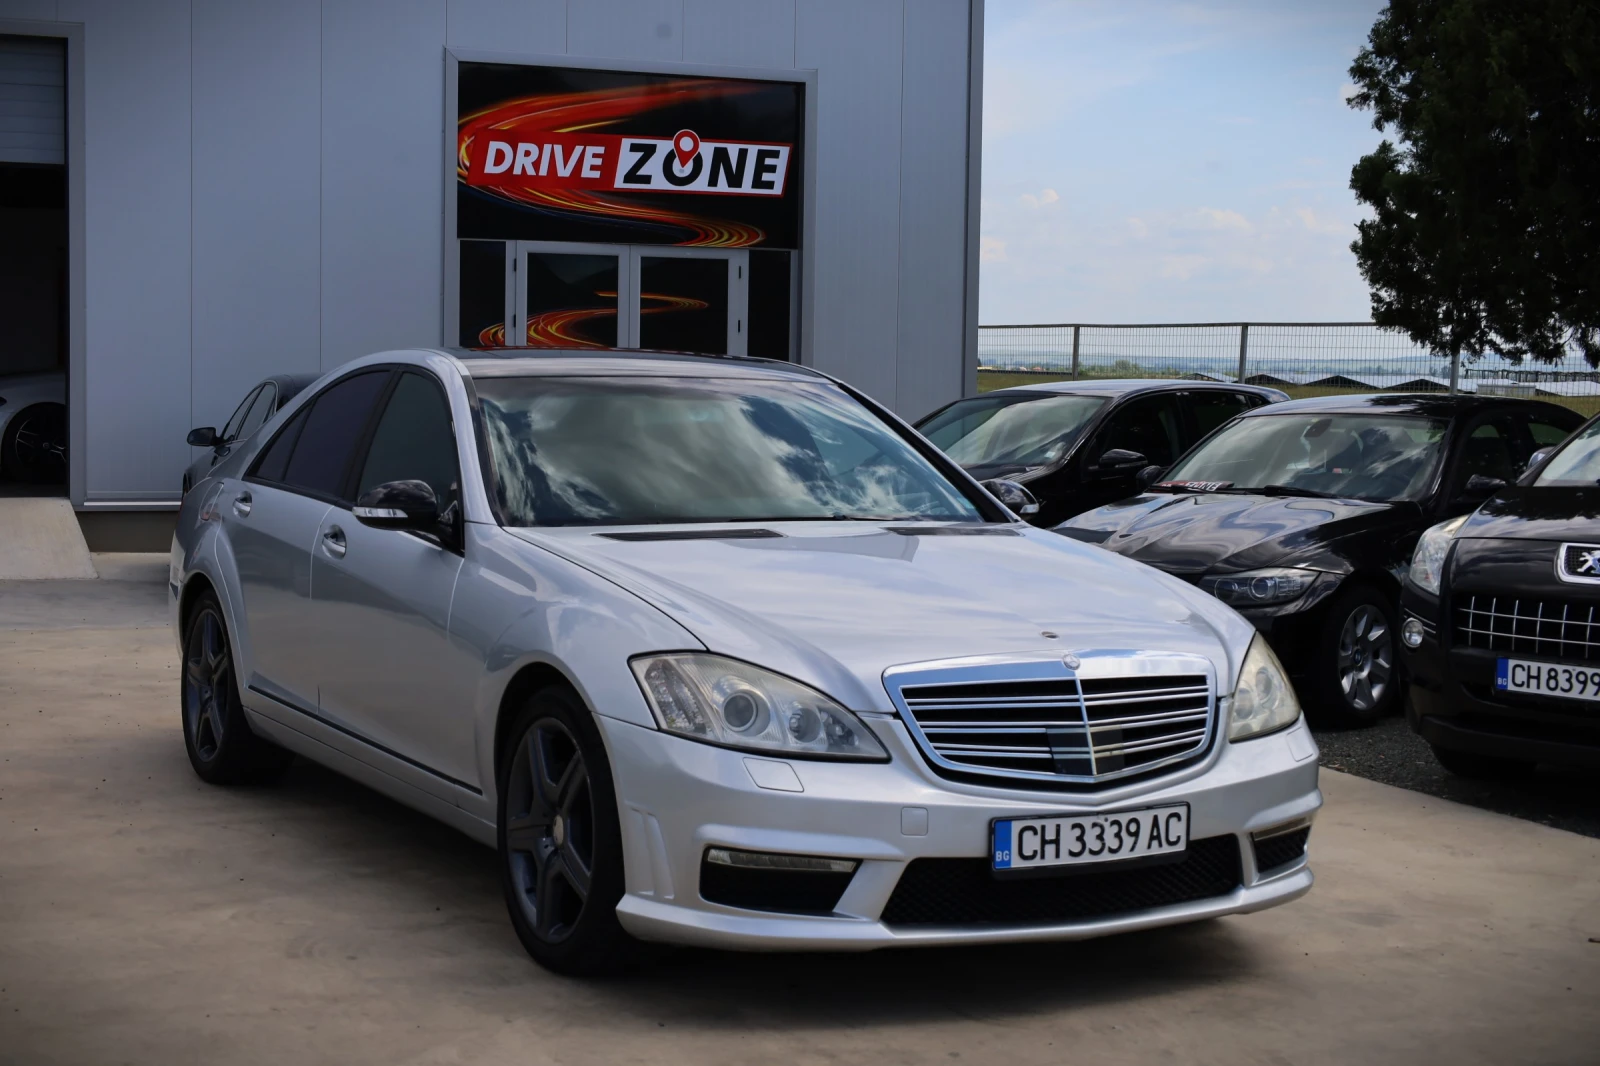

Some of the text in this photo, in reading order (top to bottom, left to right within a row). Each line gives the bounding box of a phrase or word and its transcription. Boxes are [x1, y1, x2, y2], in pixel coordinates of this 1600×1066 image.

[484, 140, 781, 191] DRIVE ZONE
[1497, 677, 1508, 686] BG
[995, 850, 1010, 862] BG
